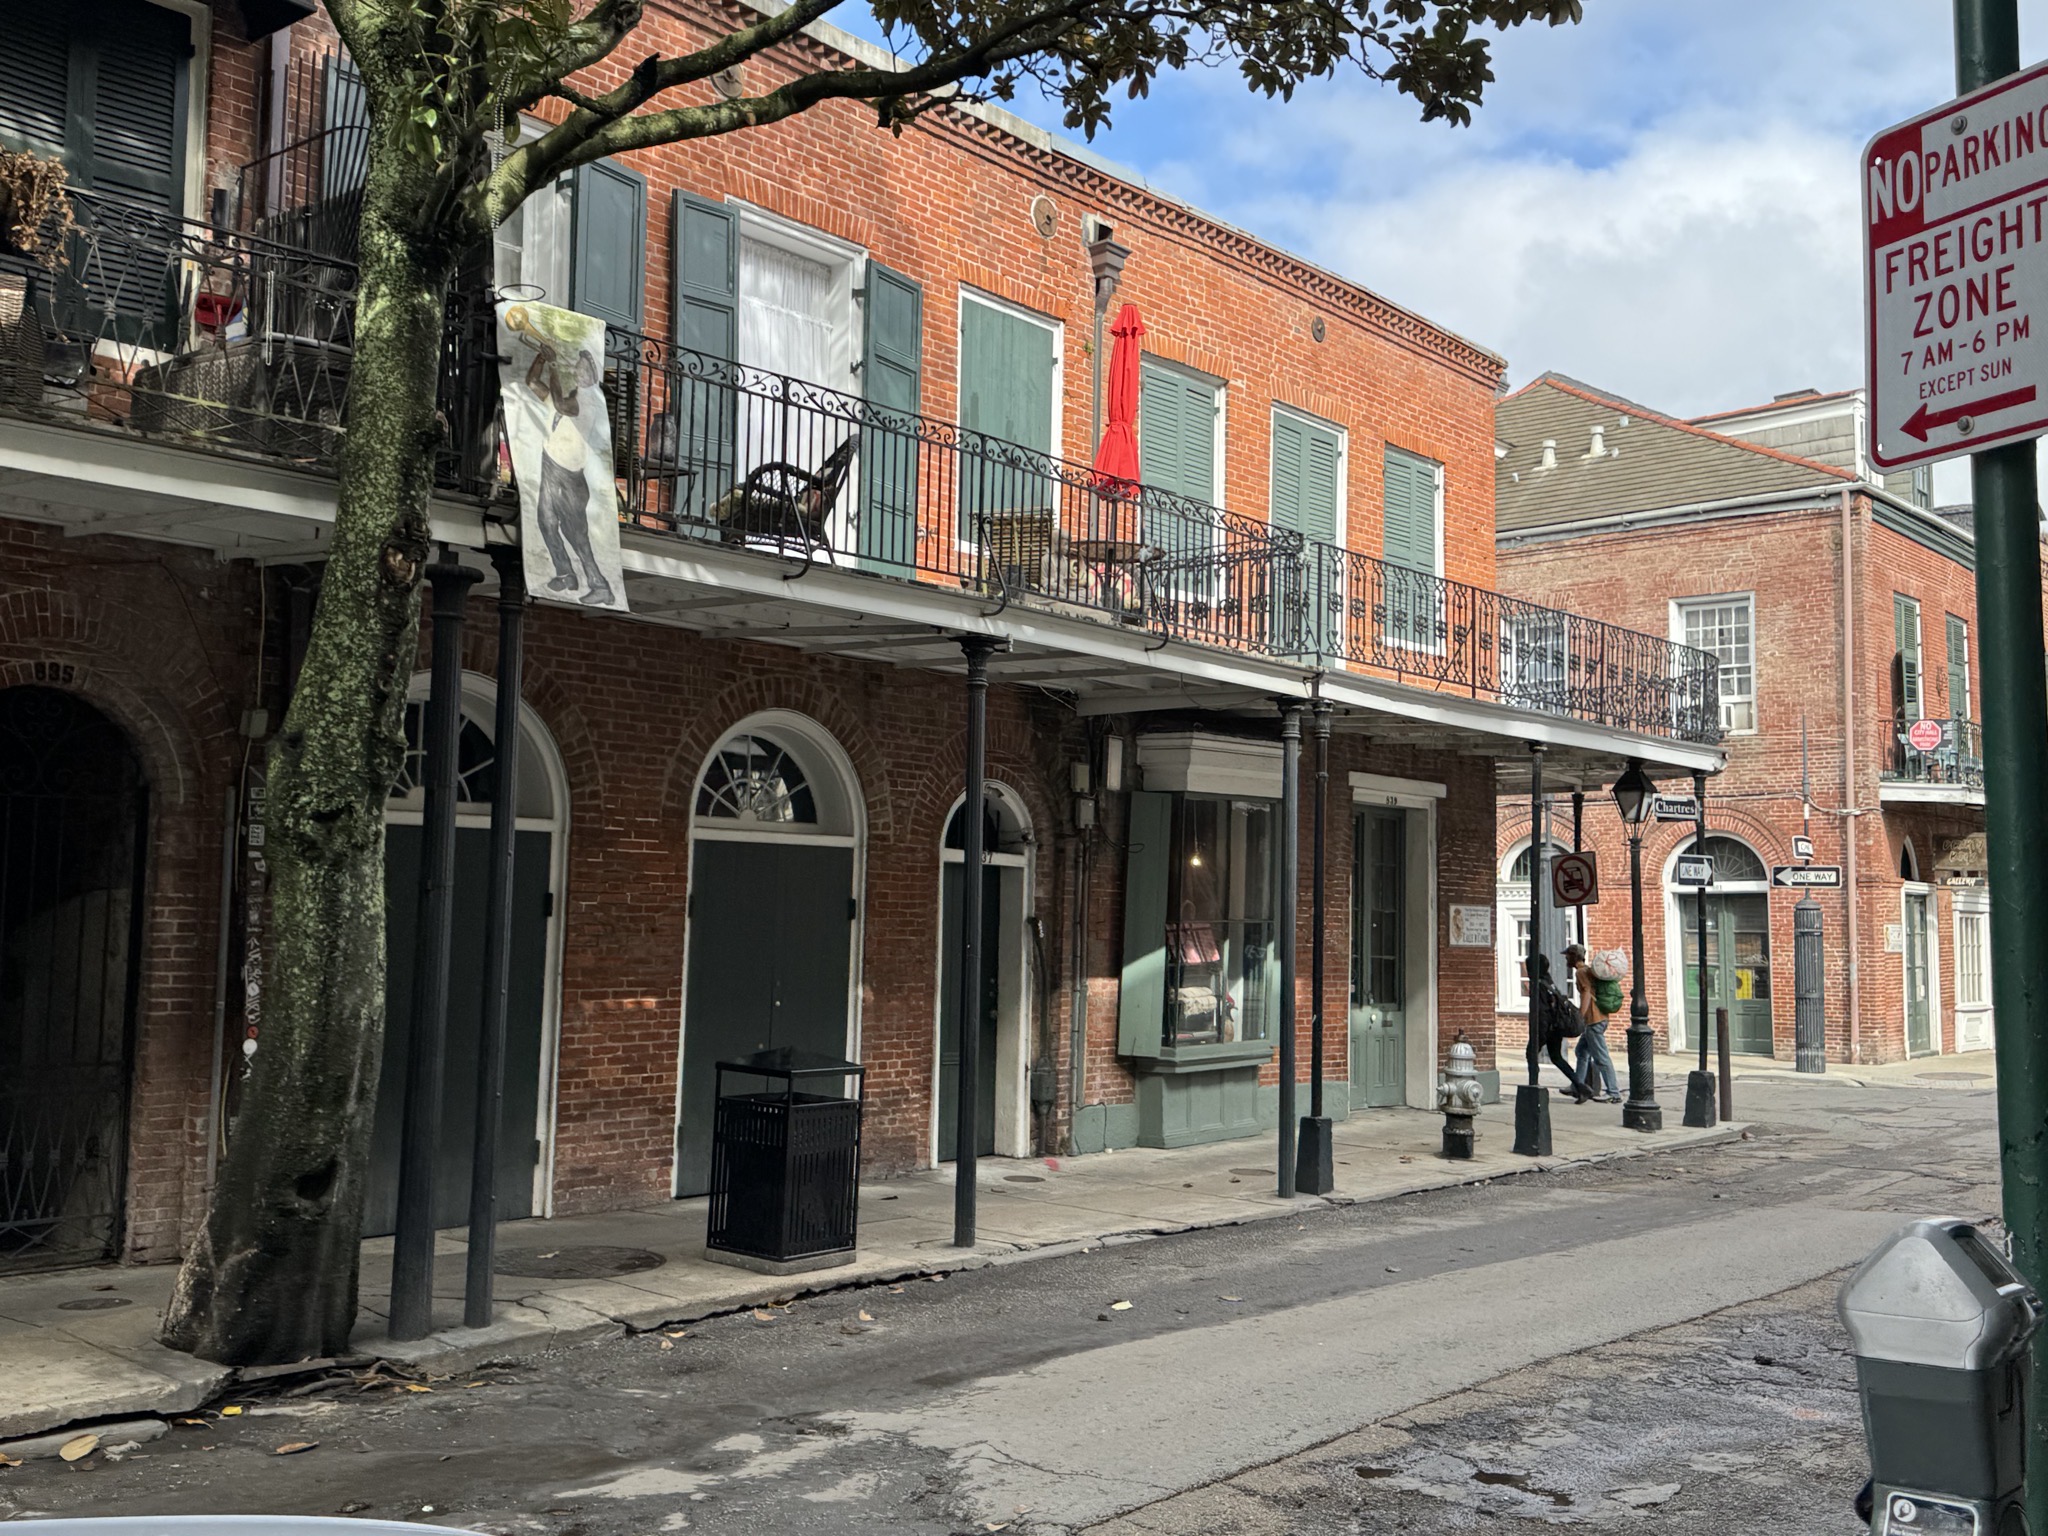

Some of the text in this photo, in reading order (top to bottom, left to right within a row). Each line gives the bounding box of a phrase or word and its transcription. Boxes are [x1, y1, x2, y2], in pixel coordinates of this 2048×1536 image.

[1870, 150, 1921, 225] NO
[1885, 195, 2048, 294] FREIGHT
[1913, 263, 2017, 339] ZONE
[1901, 351, 1913, 375] 7
[1996, 314, 2030, 347] PM
[1919, 357, 2012, 399] EXCEPT SUN
[1920, 722, 1932, 731] NO
[1655, 800, 1695, 814] Chartres
[1681, 864, 1692, 876] ONE
[1792, 872, 1833, 881] ONE WAY
